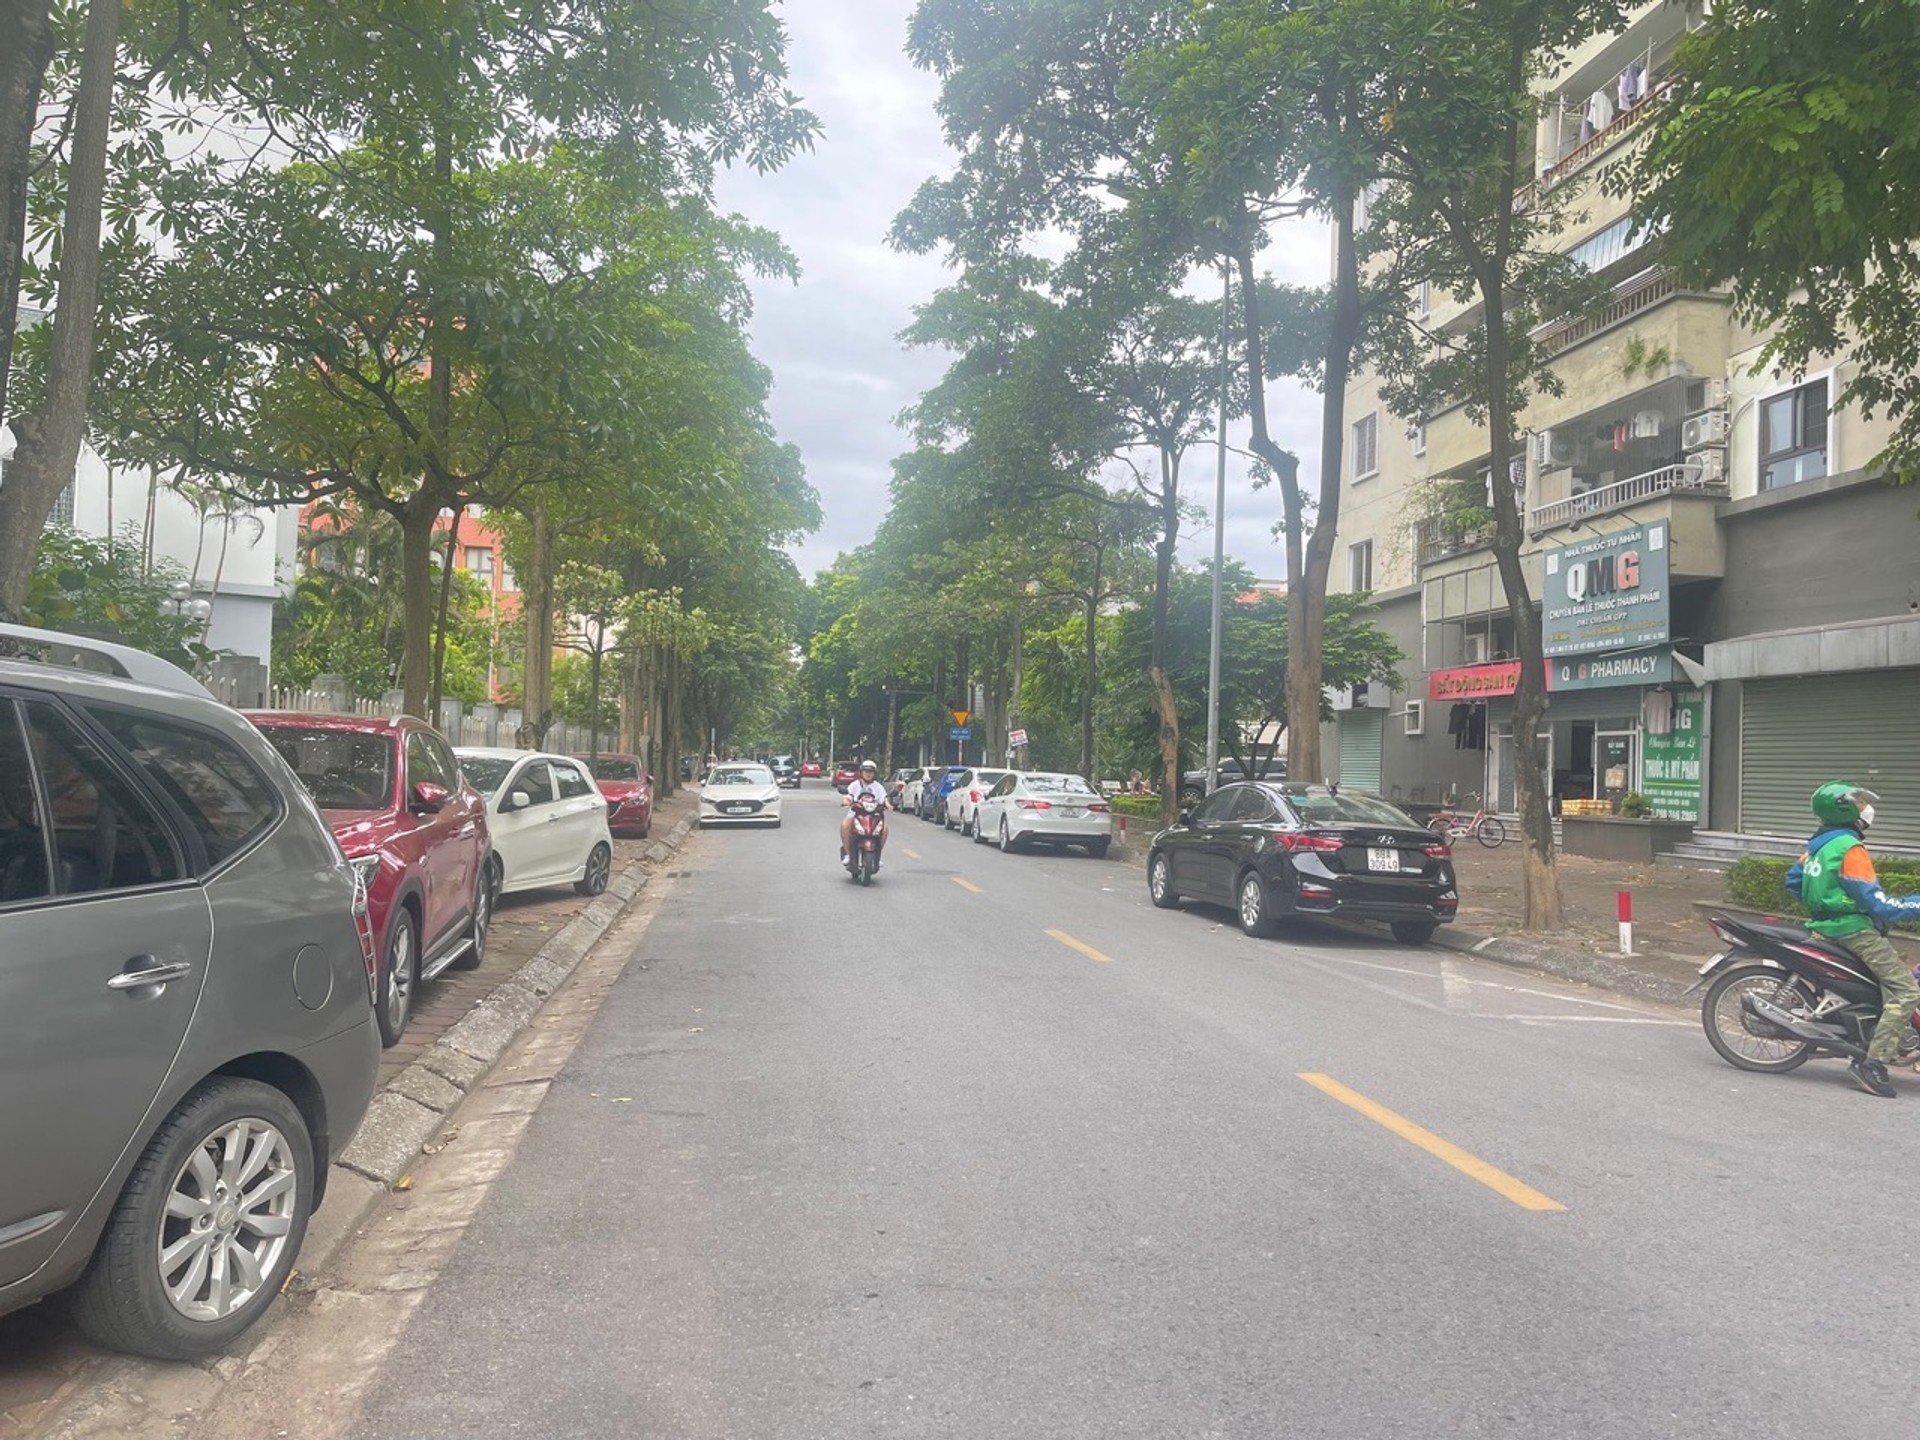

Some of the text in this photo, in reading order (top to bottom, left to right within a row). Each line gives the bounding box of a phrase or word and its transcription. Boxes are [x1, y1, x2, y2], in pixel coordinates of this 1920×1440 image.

[1581, 541, 1606, 553] THUỐC
[1566, 550, 1640, 602] QMG
[1562, 656, 1658, 681] QG PHARMACY
